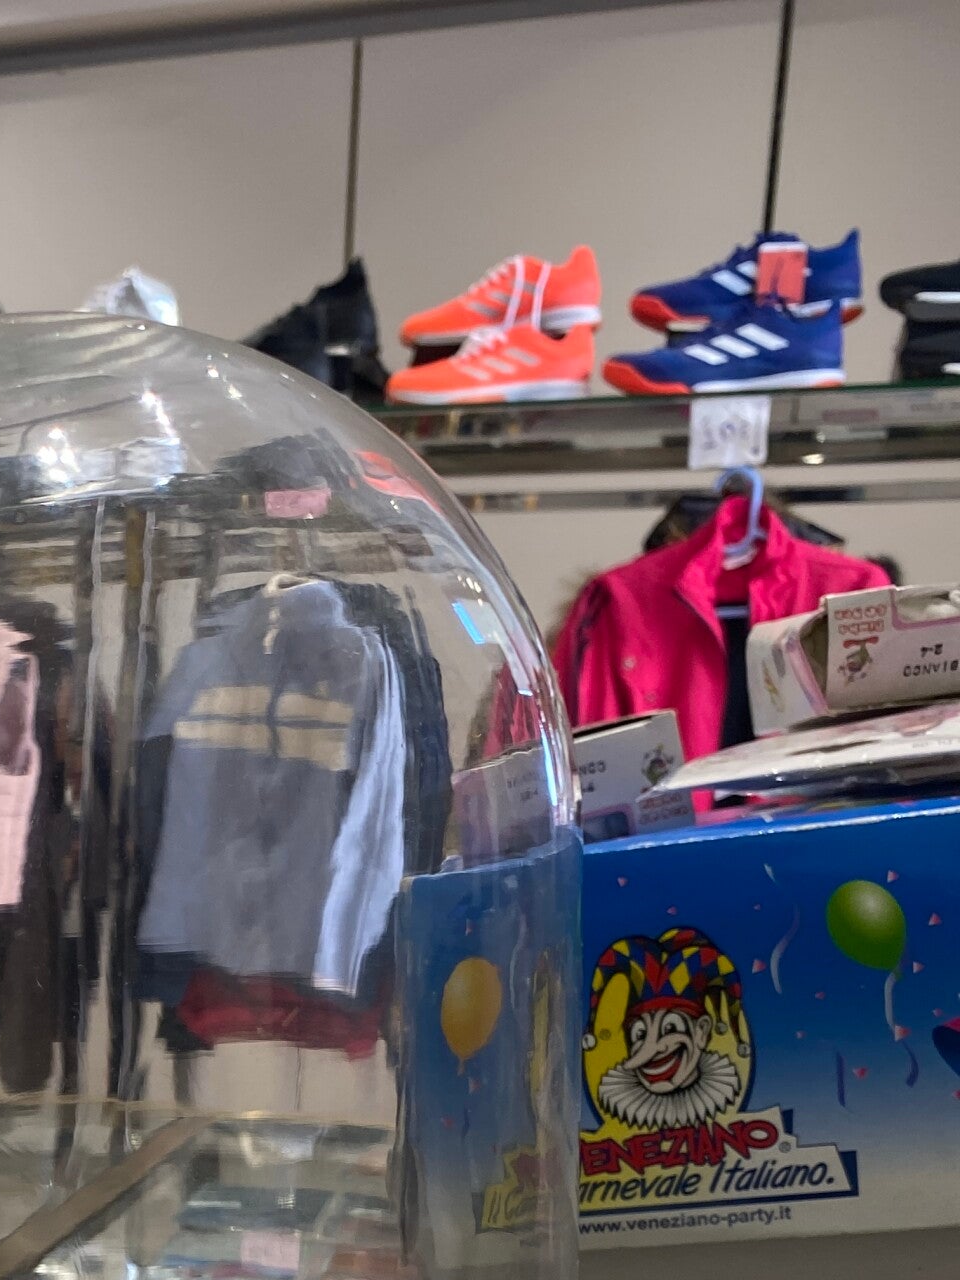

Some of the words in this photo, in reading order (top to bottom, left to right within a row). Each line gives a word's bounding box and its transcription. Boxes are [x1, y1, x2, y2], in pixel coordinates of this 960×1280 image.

[579, 1120, 779, 1176] ENEZIANO
[709, 1159, 835, 1194] Italiano.
[579, 1205, 792, 1236] www.veneziano-party.it
